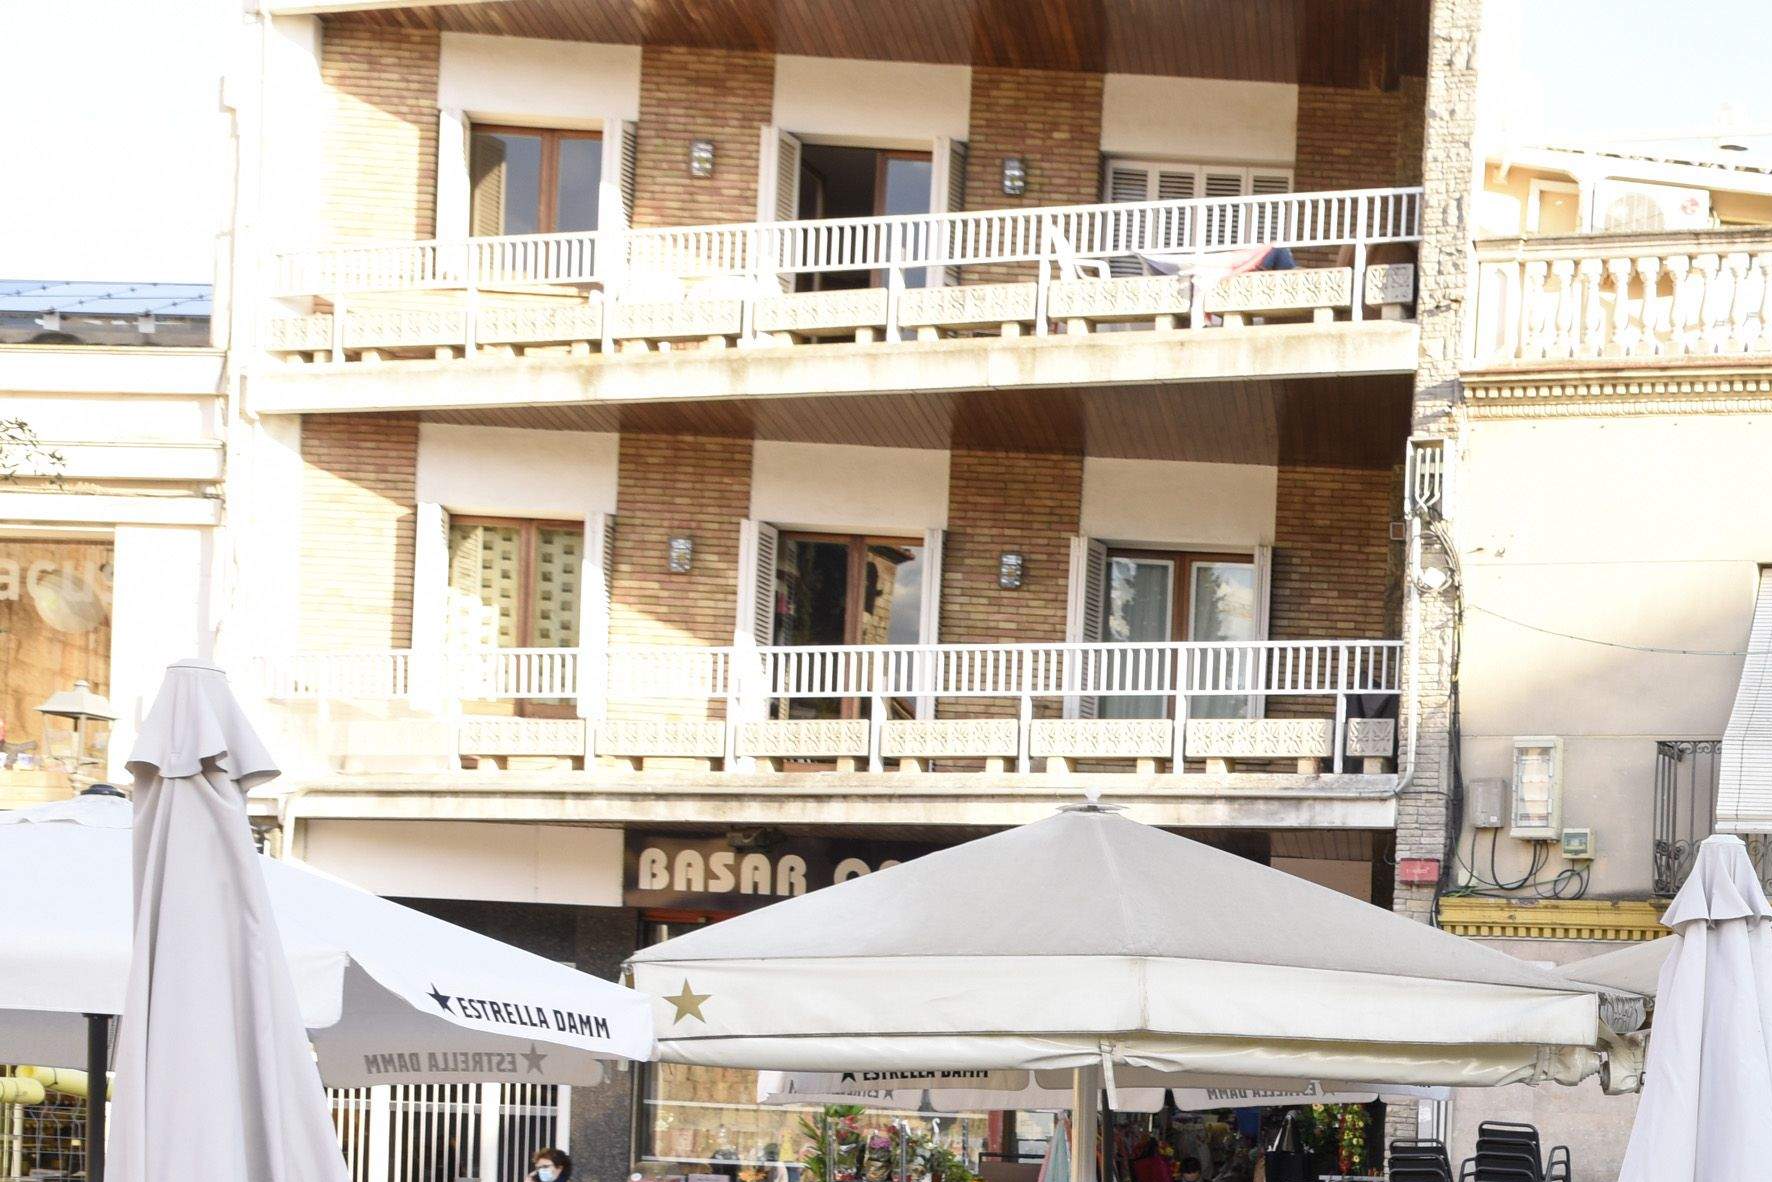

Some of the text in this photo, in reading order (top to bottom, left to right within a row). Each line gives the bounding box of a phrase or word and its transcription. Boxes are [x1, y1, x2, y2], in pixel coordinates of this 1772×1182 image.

[638, 847, 807, 897] BASAR
[456, 996, 612, 1039] ESTRELLA DAMM
